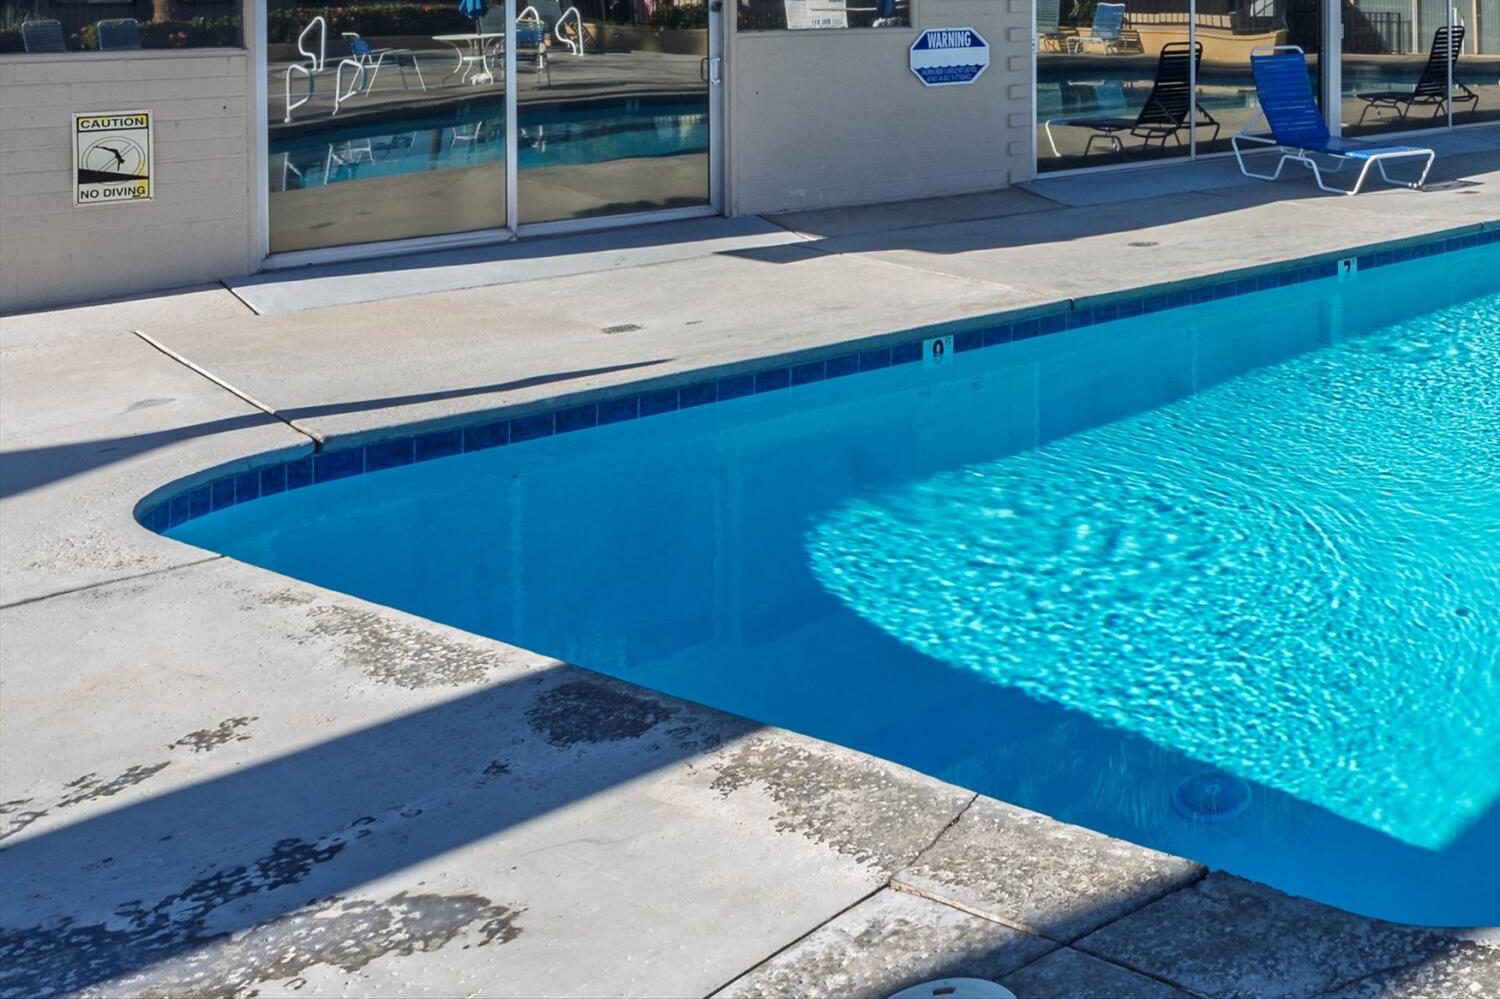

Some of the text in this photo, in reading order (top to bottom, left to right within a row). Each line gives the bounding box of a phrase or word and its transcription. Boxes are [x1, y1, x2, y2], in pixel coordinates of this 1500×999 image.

[927, 31, 972, 49] WARNING
[80, 117, 144, 129] CAUTION
[80, 185, 146, 199] NO DIVING
